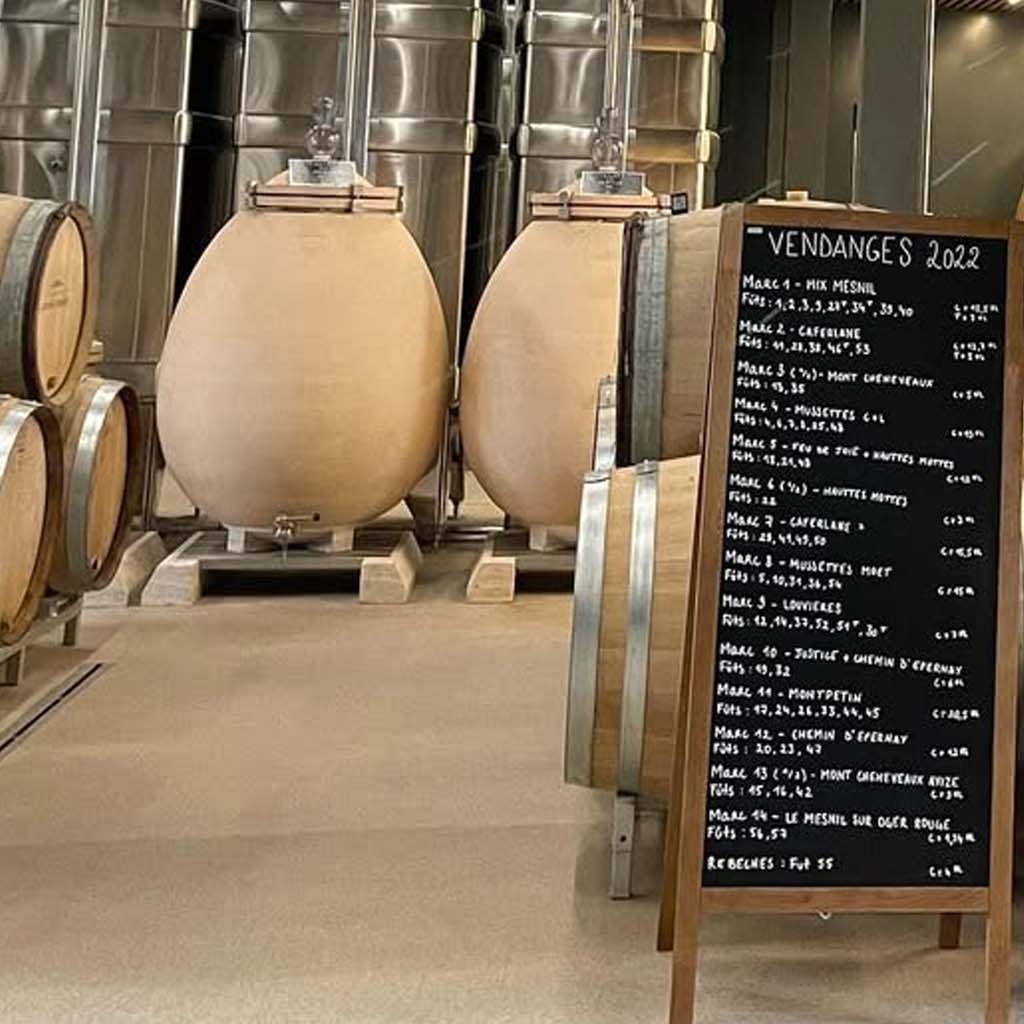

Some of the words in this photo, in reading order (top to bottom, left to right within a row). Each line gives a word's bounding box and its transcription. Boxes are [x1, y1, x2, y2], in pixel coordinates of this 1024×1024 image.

[768, 230, 913, 268] VENDANGES
[926, 240, 981, 271] 2022
[783, 279, 790, 290] 1
[806, 279, 827, 291] MIX
[832, 279, 877, 295] MESNIL
[777, 323, 786, 335] 2
[777, 363, 785, 376] 3
[771, 401, 778, 412] 4
[770, 439, 777, 450] 5
[767, 477, 774, 490] 6
[765, 515, 773, 528] 7
[766, 555, 772, 568] 8
[757, 595, 766, 610] 9
[762, 645, 778, 659] 10
[854, 654, 895, 668] CHEMIN
[756, 687, 772, 698] 11
[754, 730, 774, 741] 12
[791, 729, 836, 741] CHEMIN
[753, 766, 768, 780] 13
[820, 769, 853, 782] MONT
[751, 809, 768, 822] 14
[785, 811, 799, 825] LE
[803, 812, 848, 826] MESNIL
[852, 813, 873, 828] SUR
[877, 815, 909, 829] OGER
[914, 816, 951, 831] ROUGE
